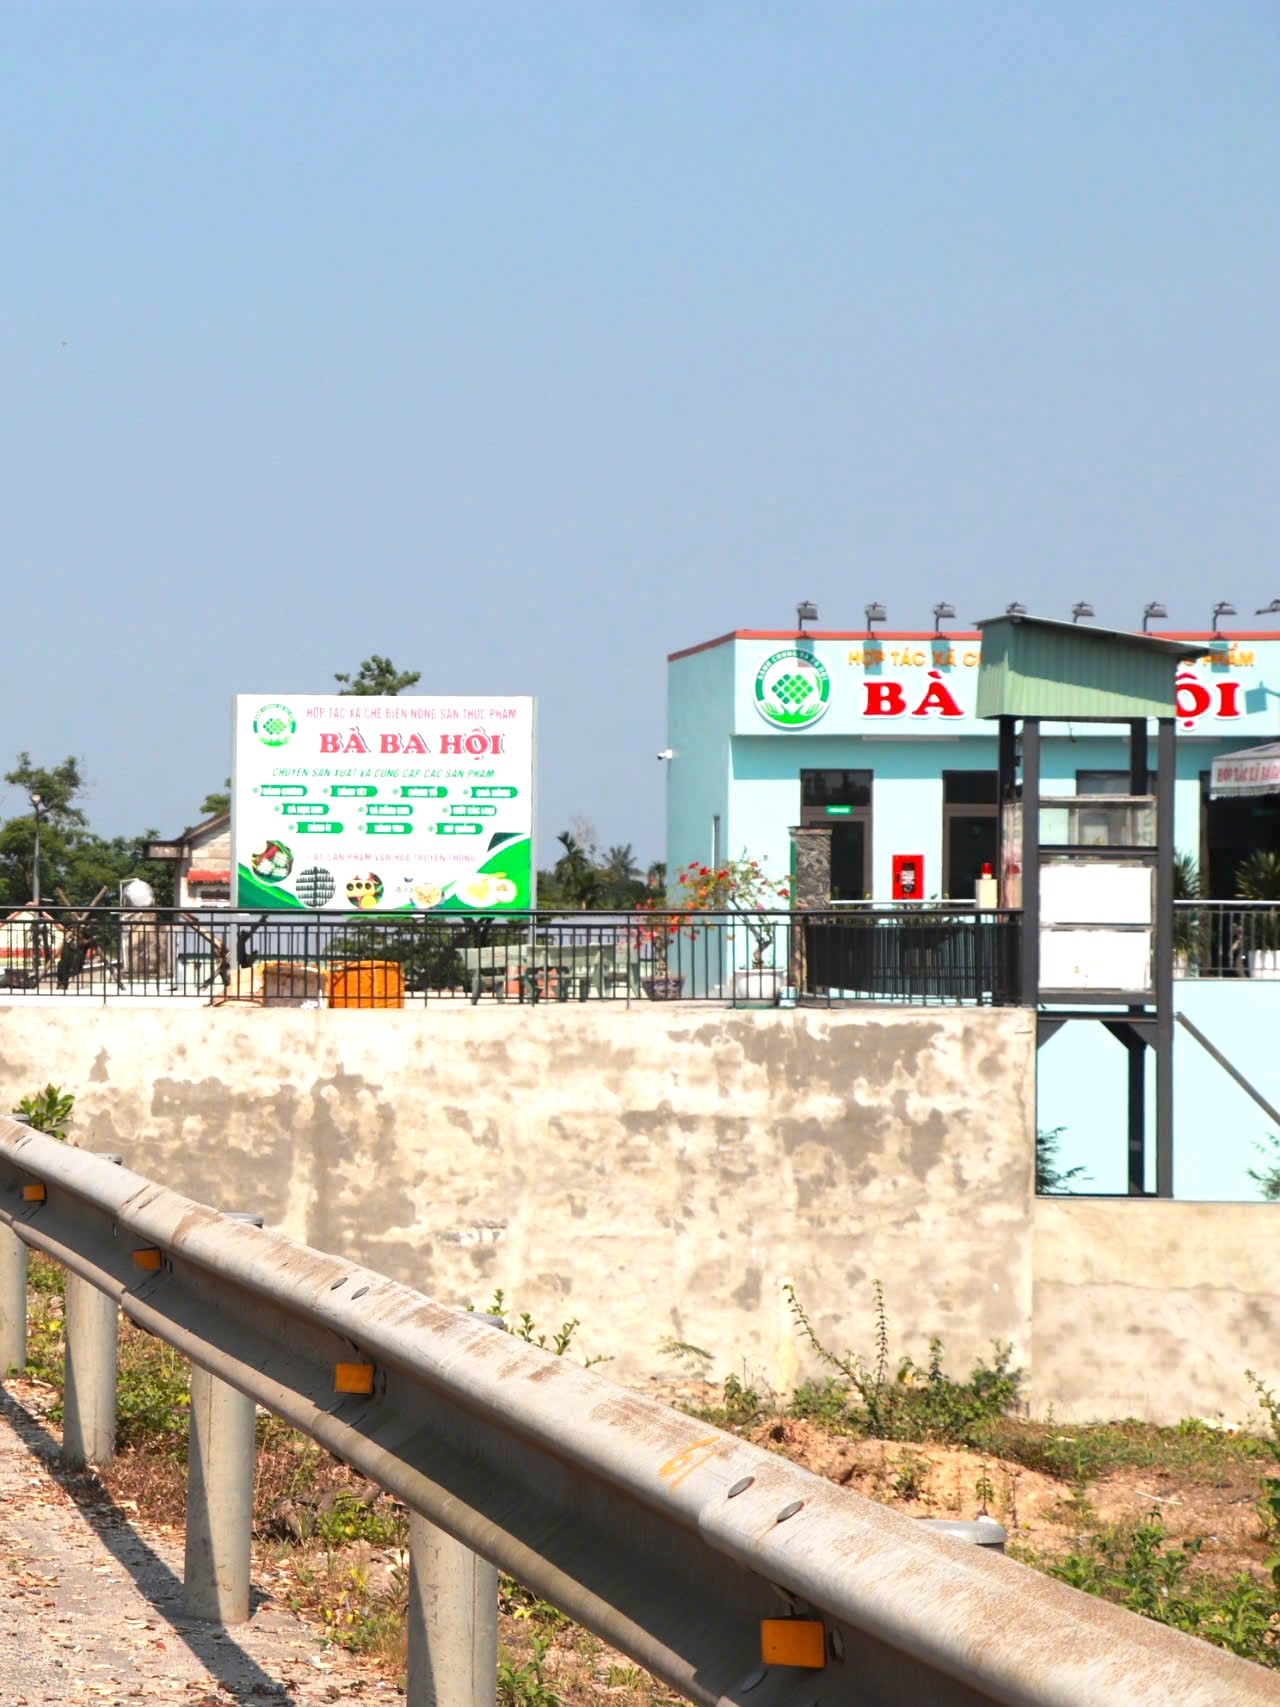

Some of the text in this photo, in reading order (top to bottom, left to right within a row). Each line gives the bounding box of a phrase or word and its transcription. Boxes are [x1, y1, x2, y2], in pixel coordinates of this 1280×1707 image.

[891, 646, 926, 667] TÁC
[863, 670, 1240, 728] BÀ ỘI
[319, 726, 505, 761] BÀ BA HỘI
